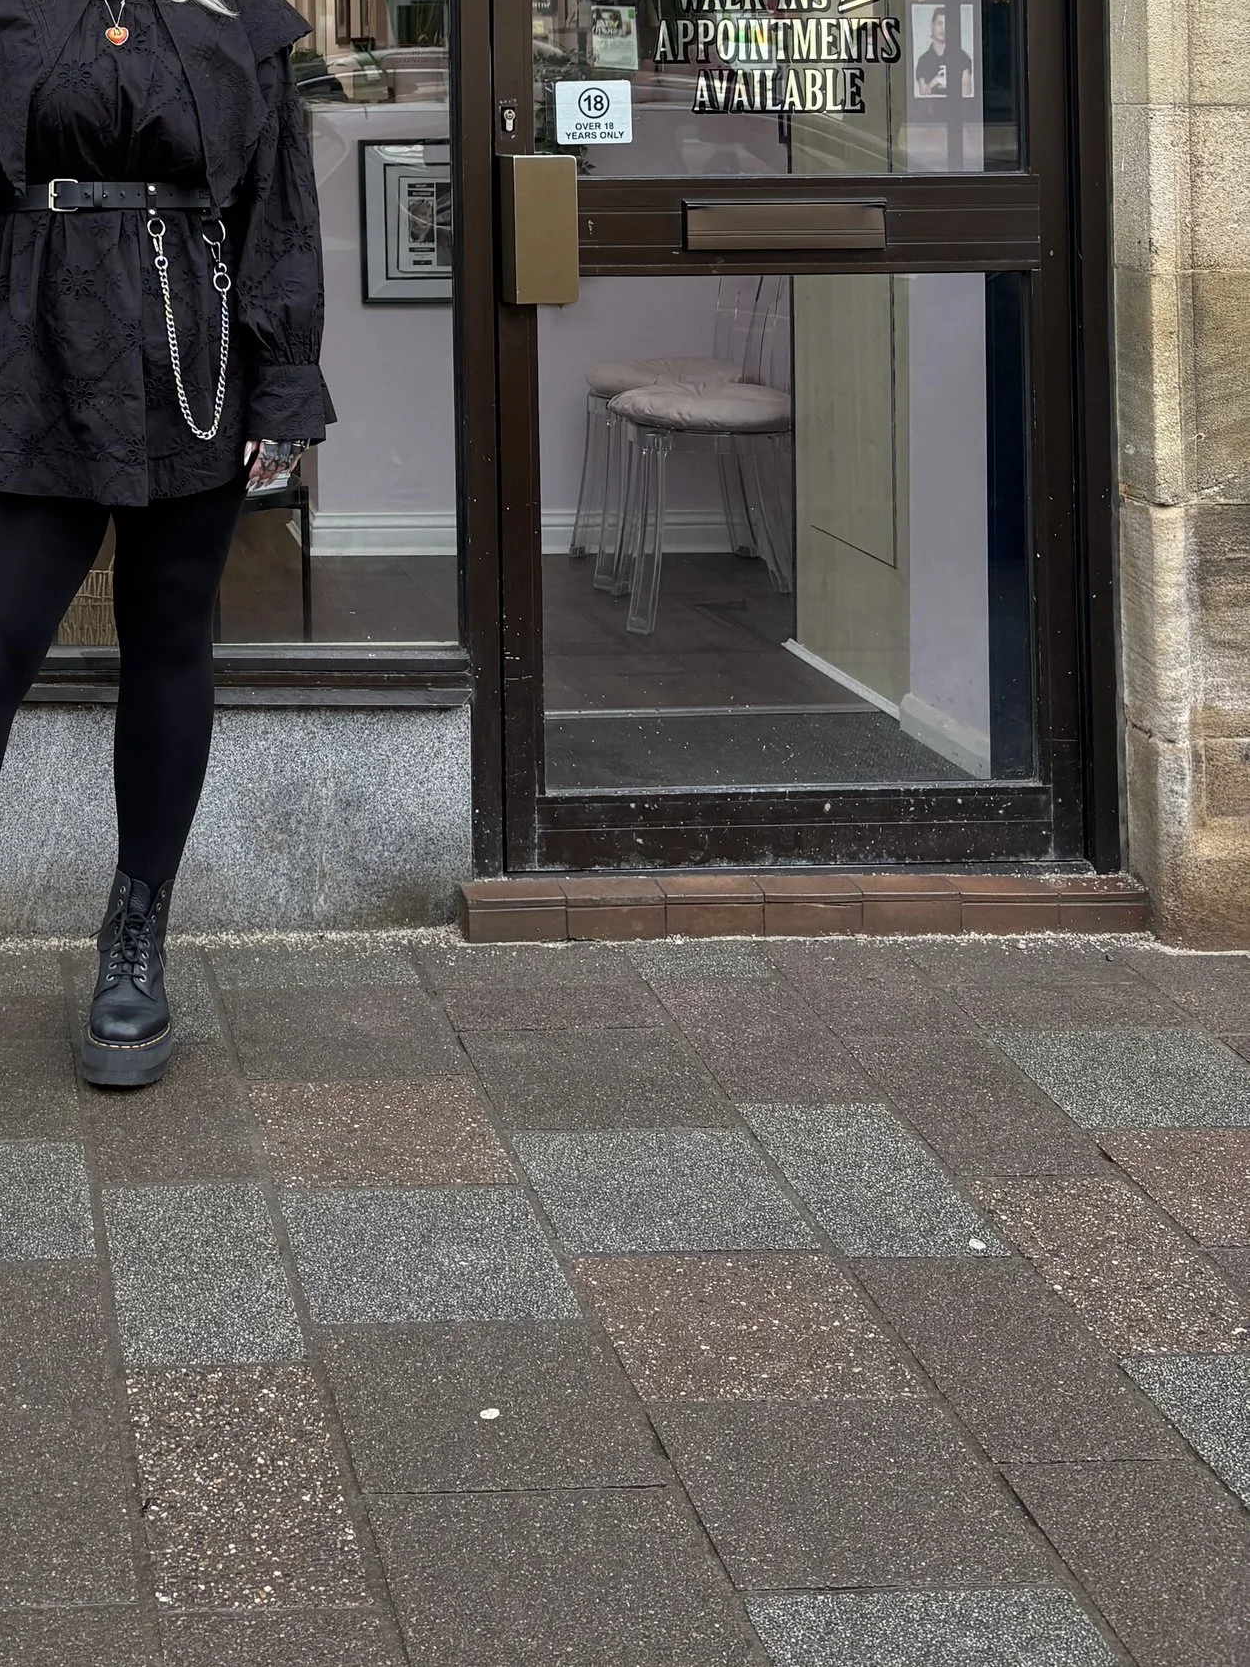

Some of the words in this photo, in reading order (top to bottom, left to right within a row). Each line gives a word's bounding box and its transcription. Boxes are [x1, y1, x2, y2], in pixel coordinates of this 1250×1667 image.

[652, 18, 902, 68] APPOINTMENTS
[691, 66, 868, 114] AVAILABLE
[583, 94, 605, 112] 18
[565, 131, 597, 140] YEARS
[599, 131, 625, 140] ONLY
[574, 122, 602, 131] OVER
[605, 122, 614, 130] 18
